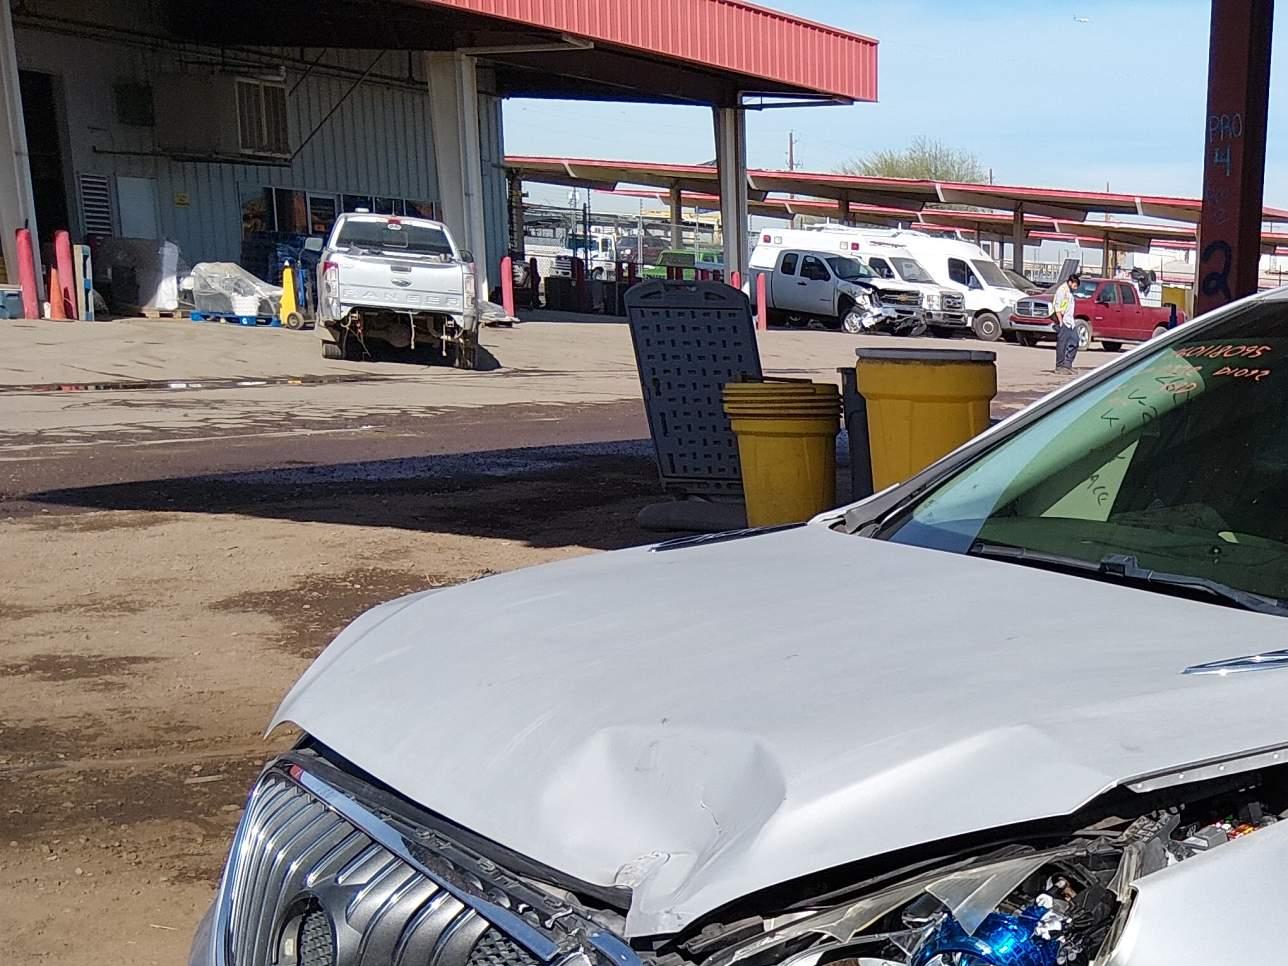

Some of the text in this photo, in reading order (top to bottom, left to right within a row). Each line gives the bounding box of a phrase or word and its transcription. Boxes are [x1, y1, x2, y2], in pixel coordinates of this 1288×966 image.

[1213, 145, 1232, 177] 4
[1201, 239, 1232, 302] 2
[341, 288, 460, 307] RANGER
